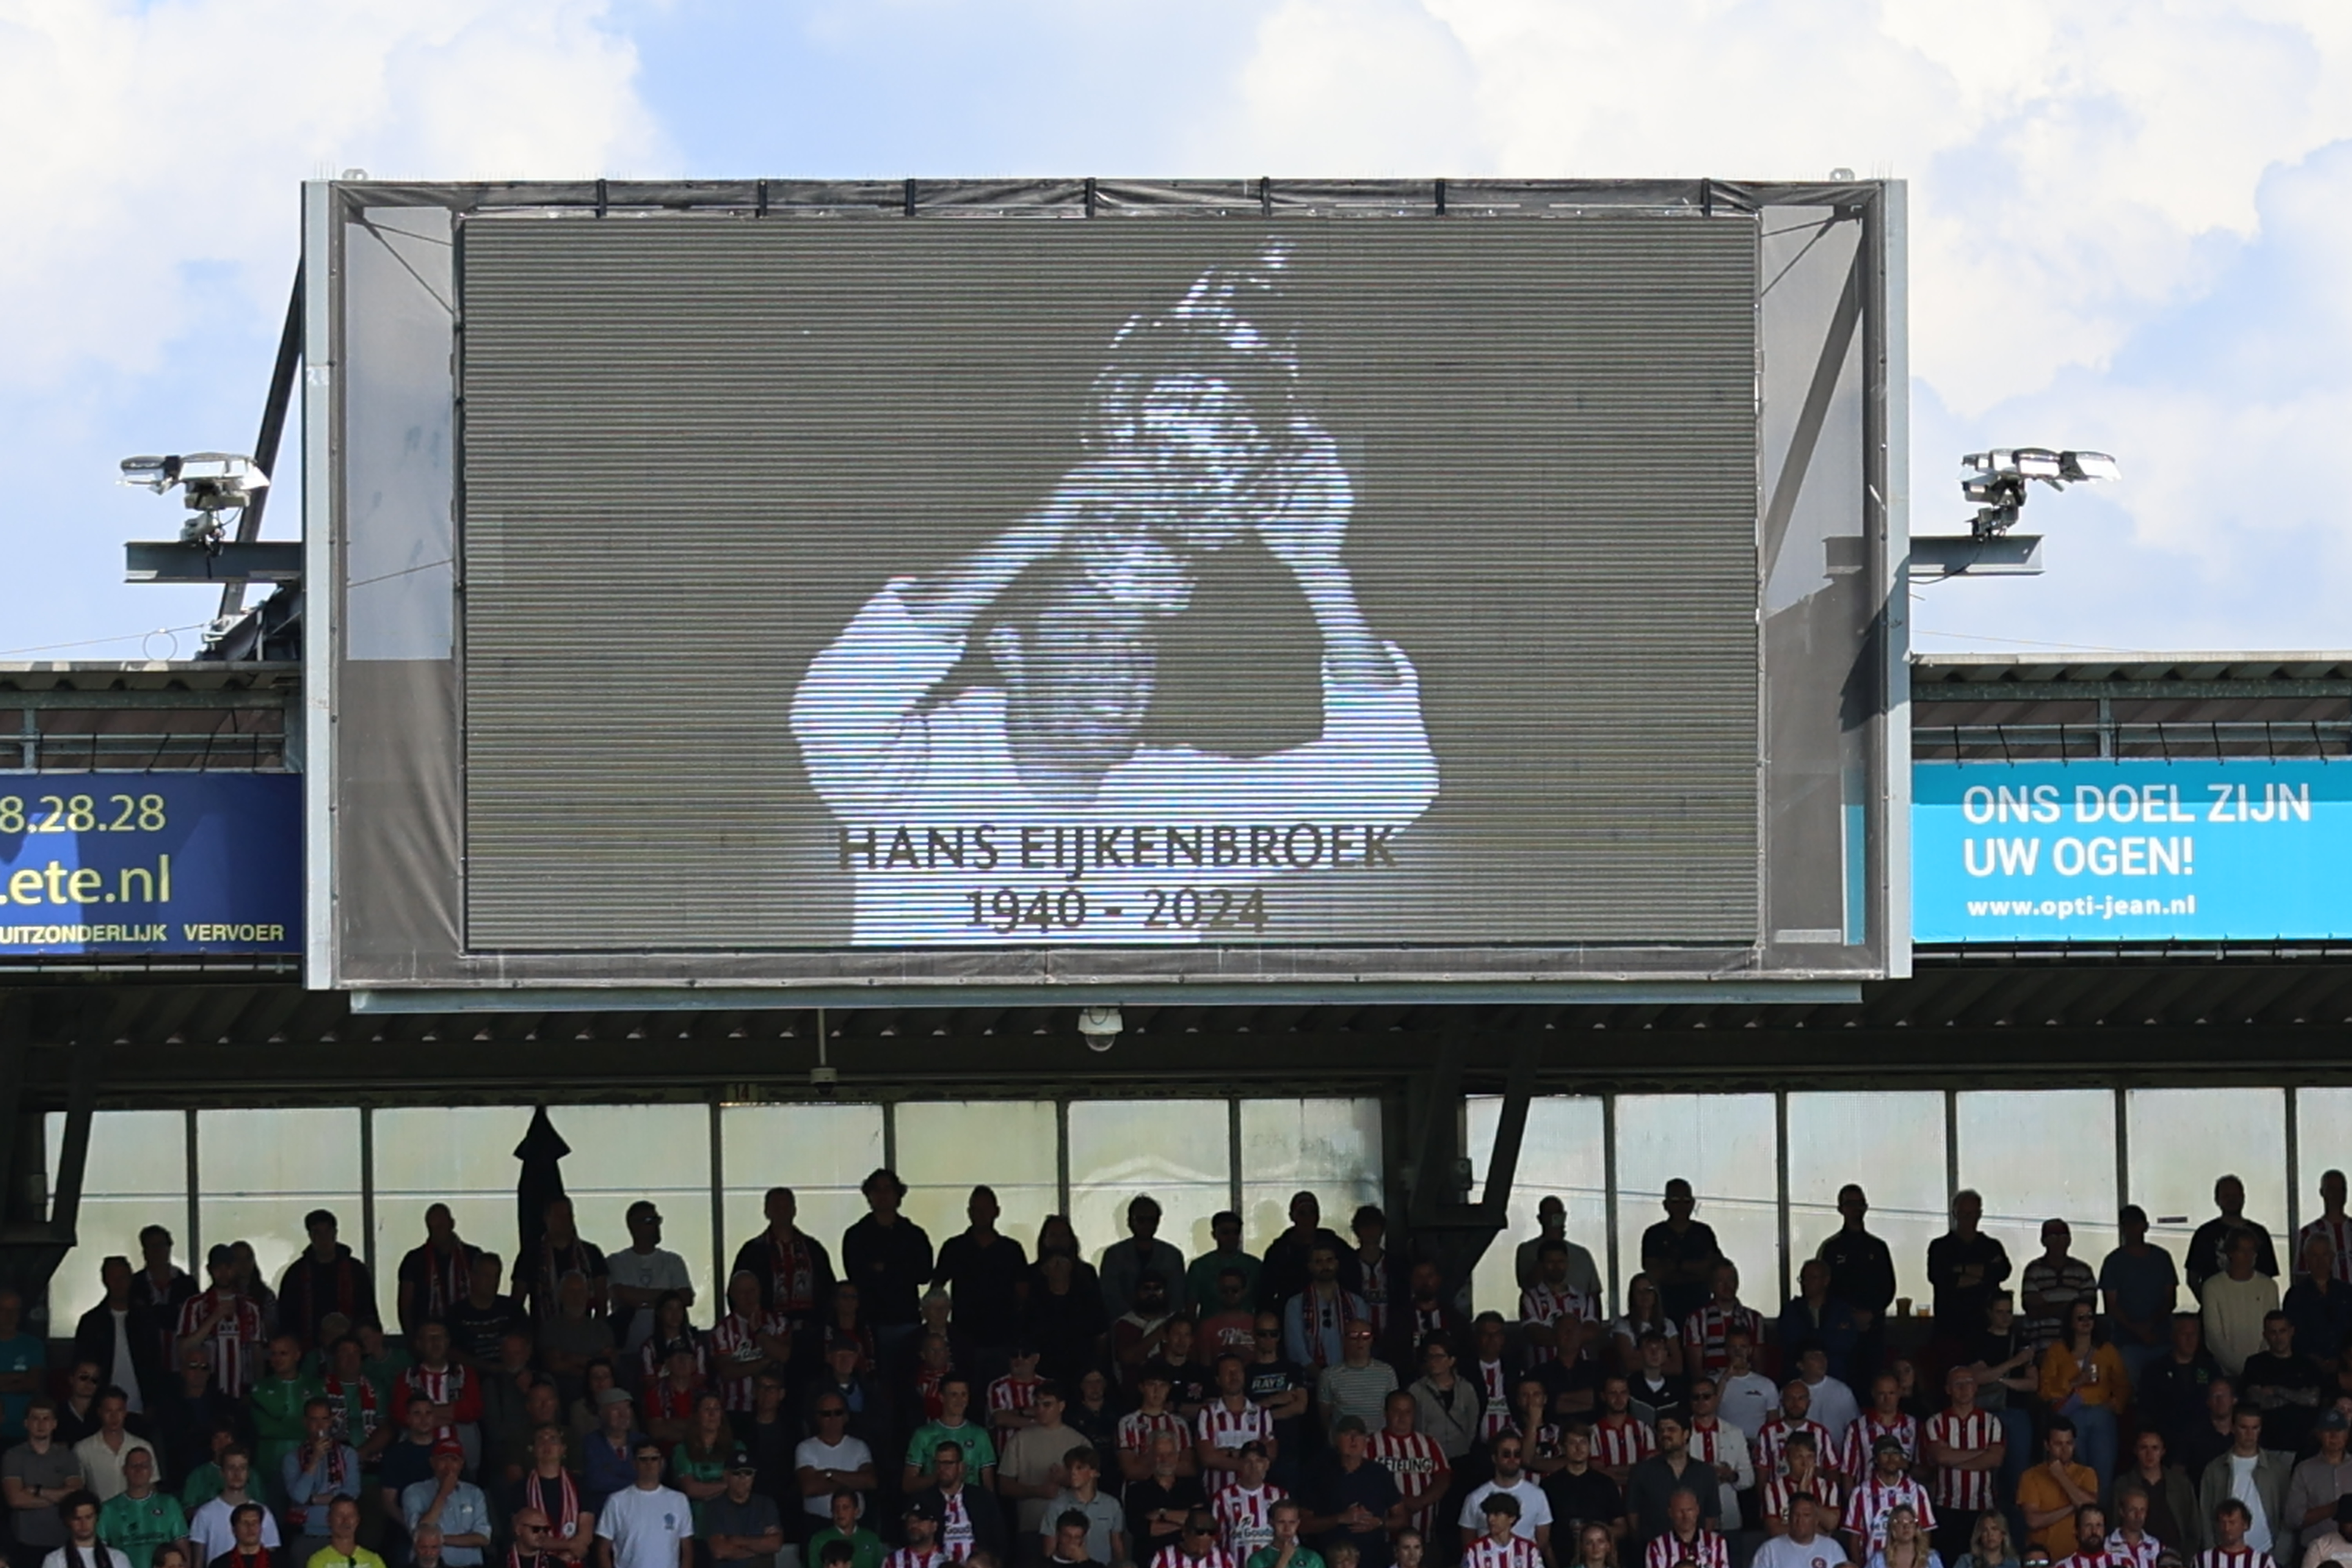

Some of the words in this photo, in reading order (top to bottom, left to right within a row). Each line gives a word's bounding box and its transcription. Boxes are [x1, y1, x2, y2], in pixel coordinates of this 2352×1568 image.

[0, 794, 166, 833] 8.28.28
[1964, 784, 2060, 824] ONS
[2075, 784, 2195, 823] DOEL
[2207, 783, 2310, 822] ZIJN
[838, 824, 999, 871] HANS
[1021, 823, 1397, 881] EIJKENBROEK
[1964, 837, 2039, 877] UW
[2053, 837, 2194, 876] OGEN!
[965, 887, 1086, 934] 1940
[1143, 887, 1270, 933] 2024
[1967, 895, 2195, 919] www.opti-jean.nl
[0, 924, 167, 944] UITZONDERLIJK
[183, 924, 284, 942] VERVOER
